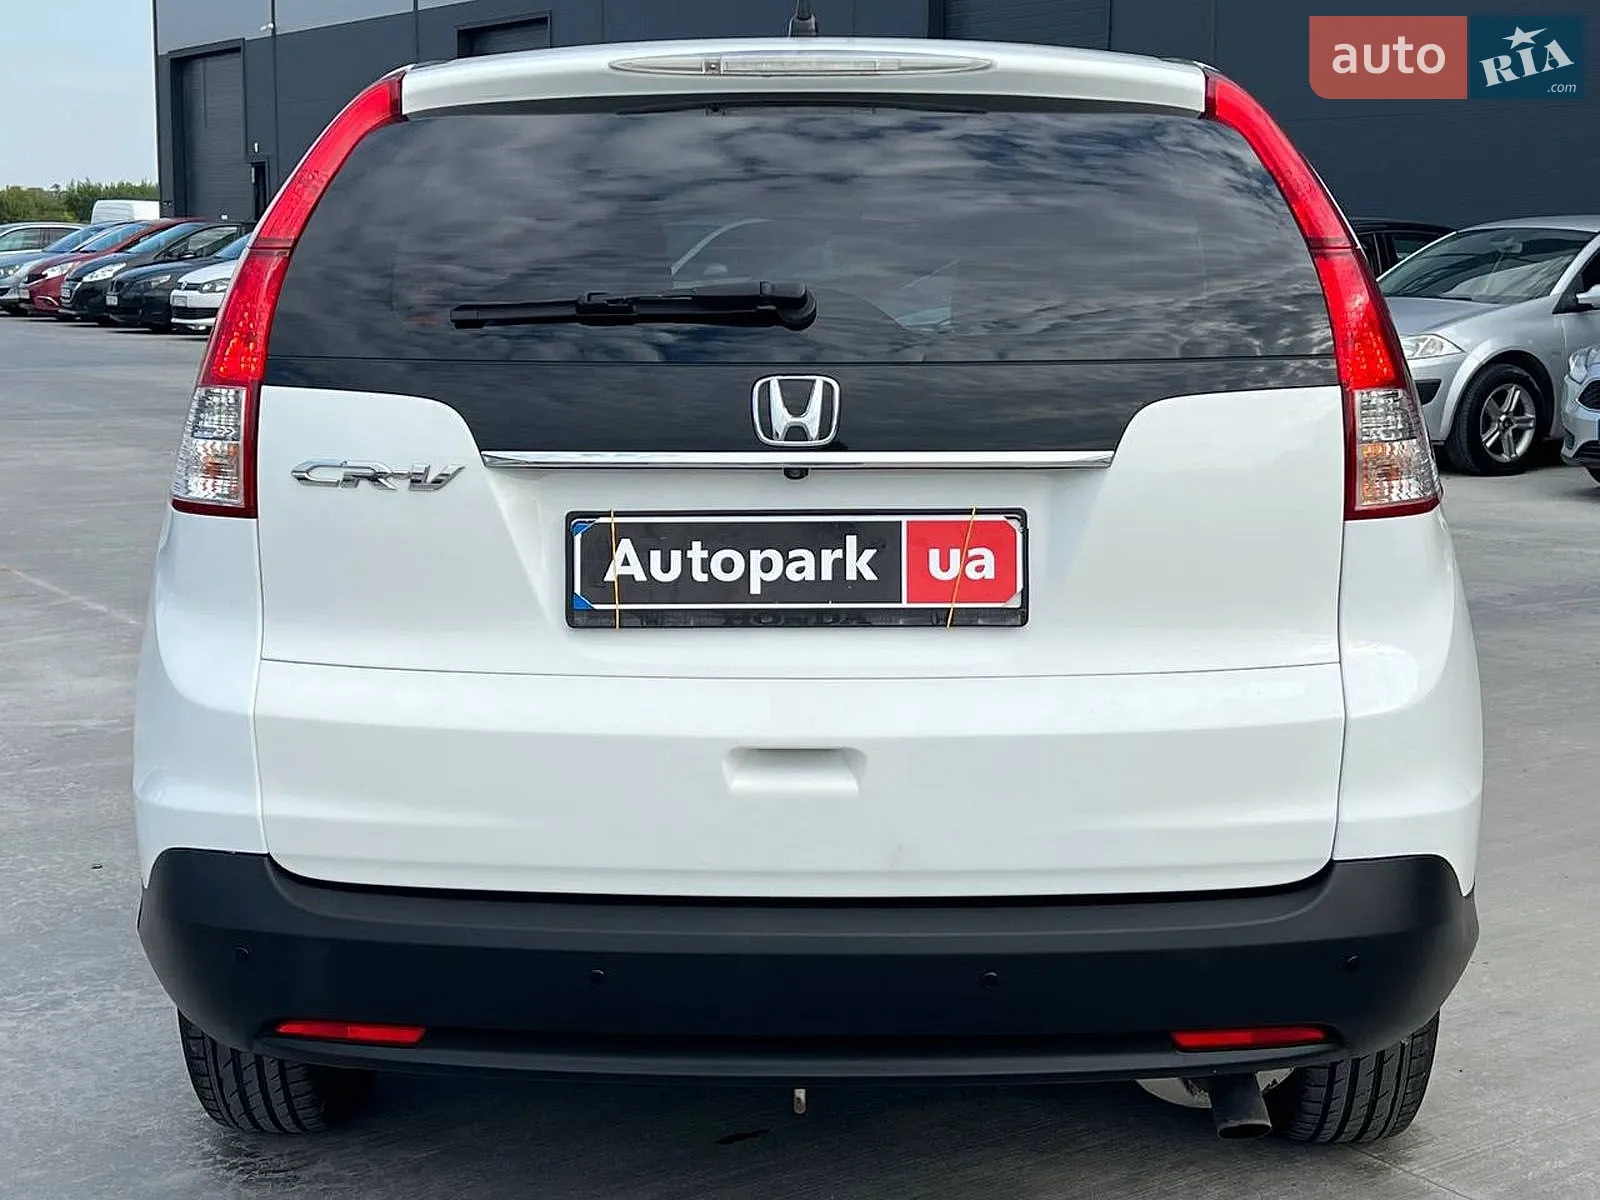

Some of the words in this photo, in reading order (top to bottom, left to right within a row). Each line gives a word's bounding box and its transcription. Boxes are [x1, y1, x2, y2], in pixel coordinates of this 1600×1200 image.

[291, 458, 466, 492] CR-V
[603, 534, 878, 595] Autopark
[928, 546, 996, 581] ua
